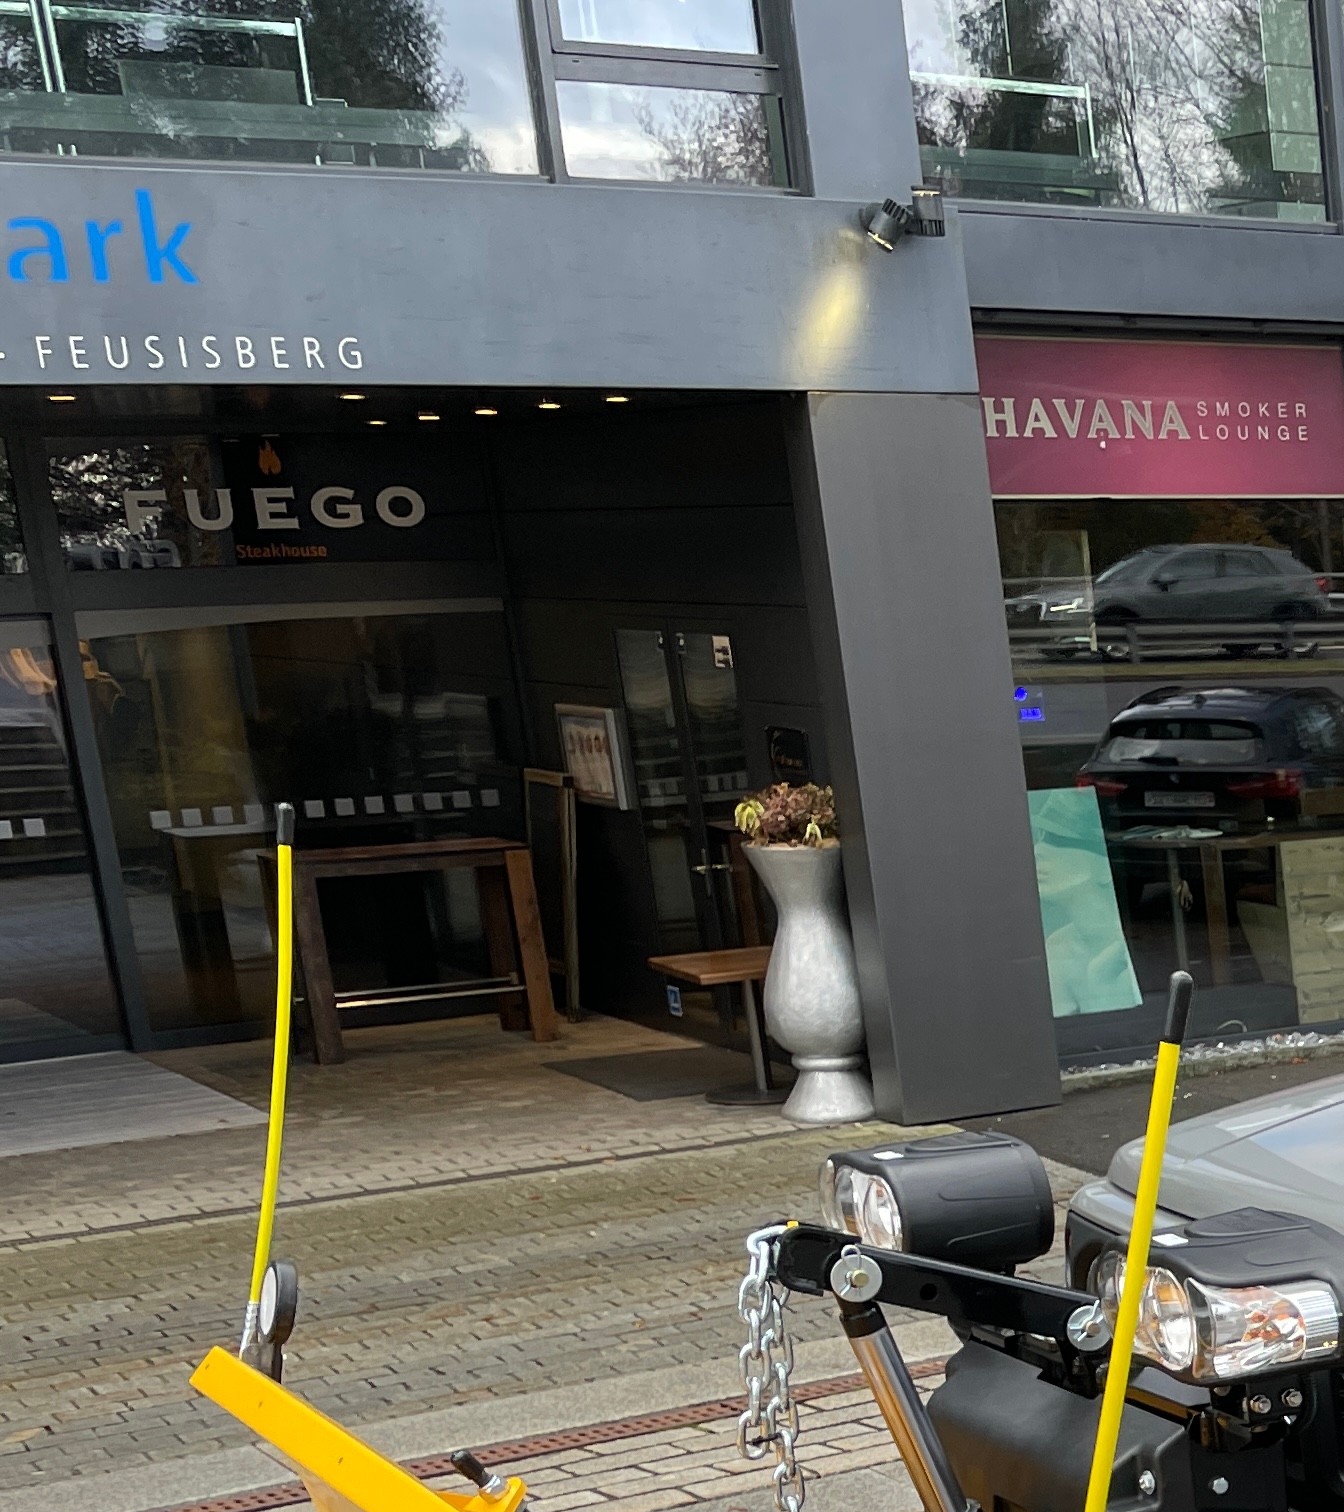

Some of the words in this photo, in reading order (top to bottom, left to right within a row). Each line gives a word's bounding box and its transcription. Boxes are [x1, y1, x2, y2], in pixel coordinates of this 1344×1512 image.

[7, 187, 199, 284] ark
[35, 335, 364, 370] FEUSISBERG
[982, 397, 1191, 440] HAVANA
[1197, 401, 1308, 418] SMOKER
[1198, 424, 1309, 441] LOUNGE
[122, 485, 426, 533] FUEGO
[235, 542, 328, 559] Steakhouse
